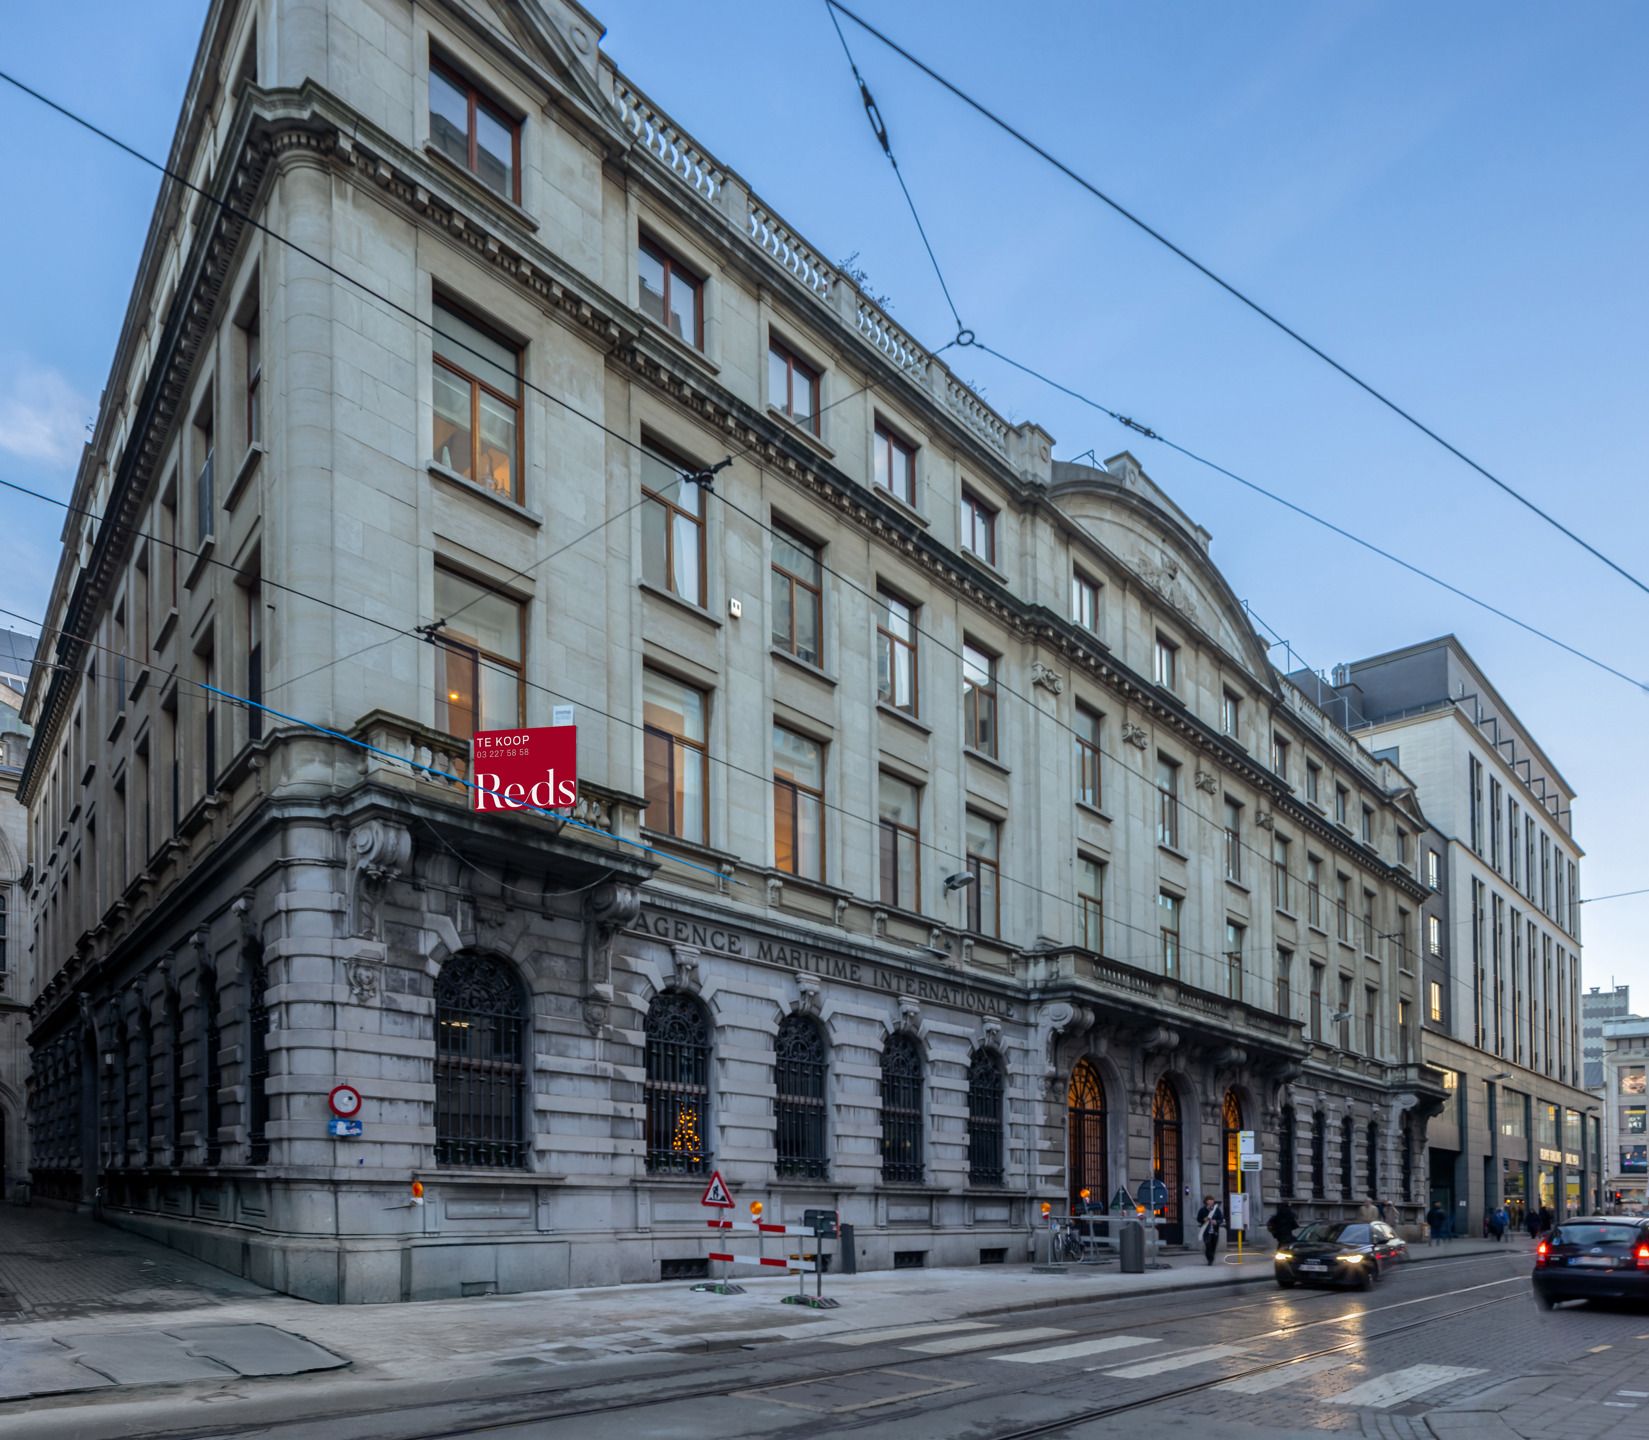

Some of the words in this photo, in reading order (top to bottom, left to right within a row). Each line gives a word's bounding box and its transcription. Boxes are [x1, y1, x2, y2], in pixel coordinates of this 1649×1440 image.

[477, 738, 492, 748] TE
[495, 735, 530, 746] KOOP
[477, 751, 487, 759] 03
[489, 750, 504, 758] 227
[476, 768, 576, 810] Reds
[633, 911, 743, 954] AGENCE
[756, 941, 861, 982] MARITIME
[873, 969, 1015, 1018] INTERNATIONALE
